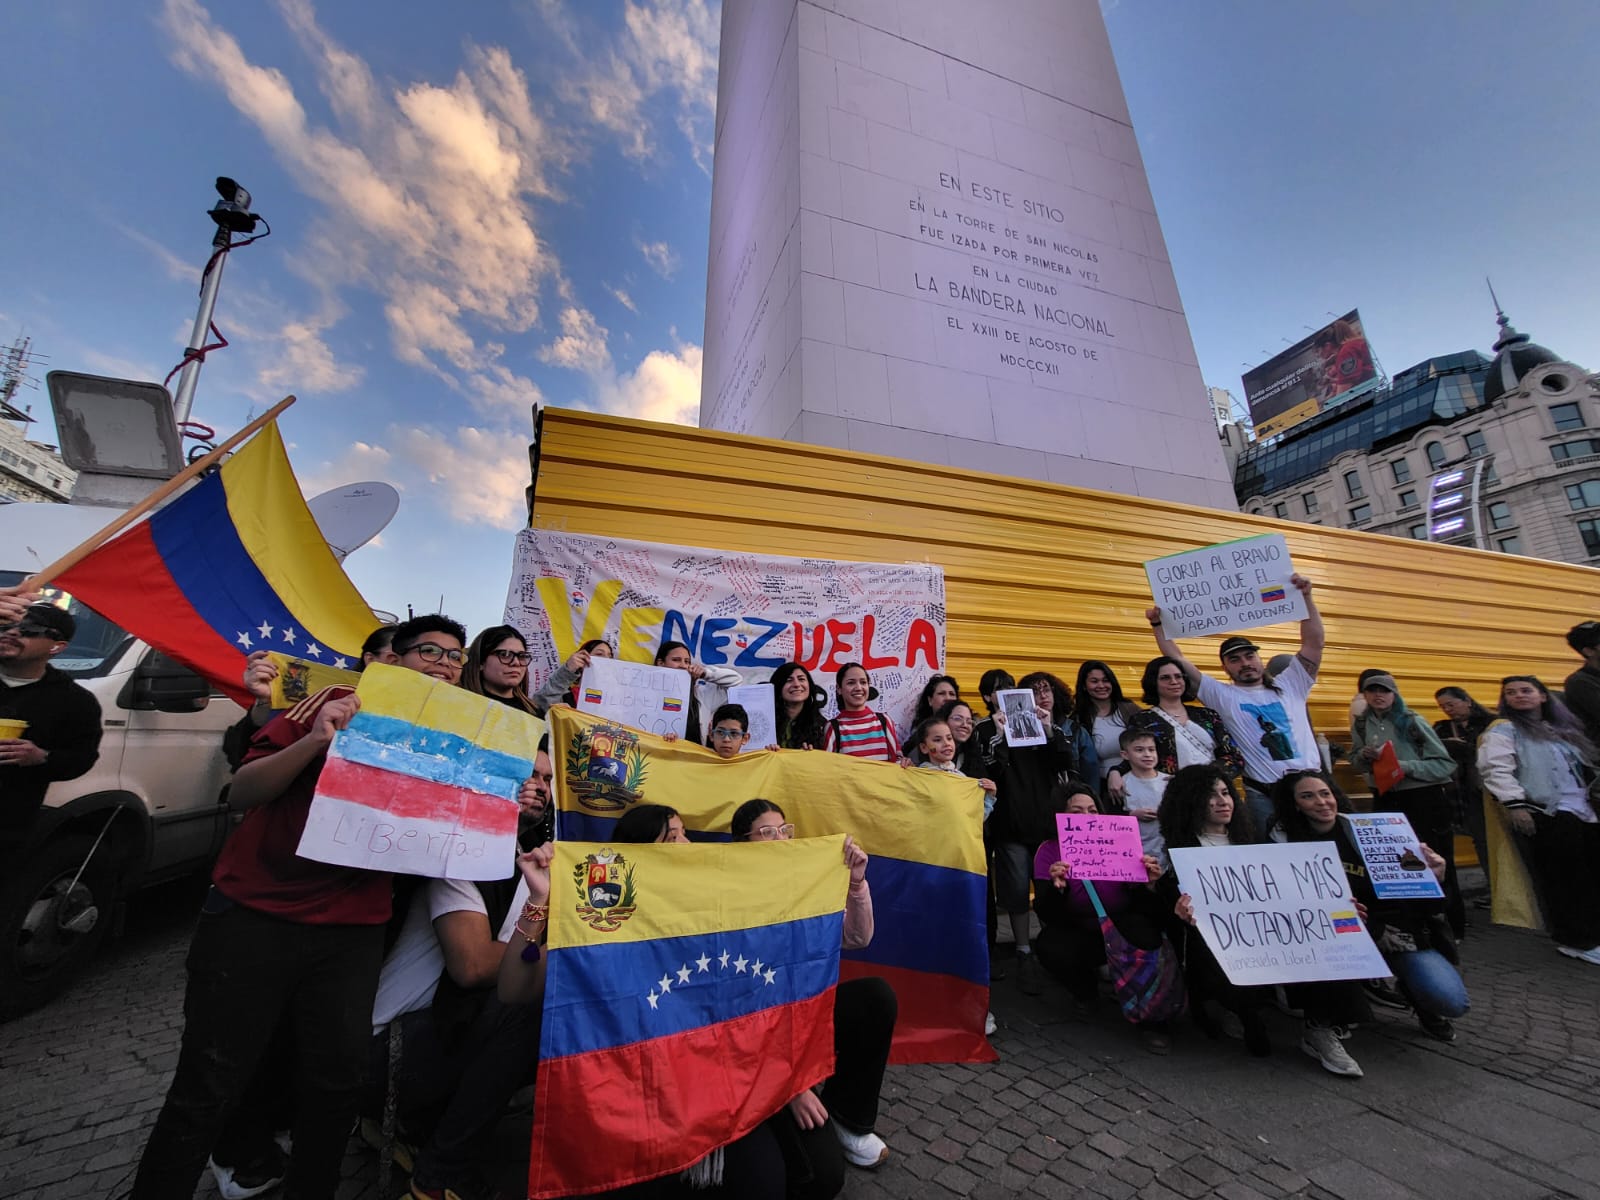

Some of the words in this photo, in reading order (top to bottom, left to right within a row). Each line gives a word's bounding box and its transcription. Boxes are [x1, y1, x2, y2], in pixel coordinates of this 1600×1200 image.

[939, 172, 961, 192] EN
[972, 182, 1014, 208] ESTE
[1023, 199, 1064, 223] SITIO
[909, 199, 925, 212] EN
[933, 207, 948, 219] LA
[956, 213, 996, 233] TORRE
[1004, 228, 1019, 240] DE
[1026, 234, 1047, 248] SAN
[1053, 243, 1099, 263] NICOLAS
[920, 225, 944, 240] FUE
[952, 234, 986, 252] IZADA
[994, 246, 1018, 261] POR
[1025, 255, 1072, 276] PRIMERA
[1078, 269, 1100, 283] VEZ
[973, 265, 989, 278] EN
[995, 271, 1010, 283] LA
[1017, 278, 1057, 296] CIUDAD
[914, 272, 938, 294] LA
[949, 281, 1026, 316] BANDERA
[1034, 303, 1114, 338] NACIONAL
[947, 317, 963, 330] EL
[972, 322, 998, 338] XXIII
[1005, 331, 1020, 343] DE
[1029, 336, 1077, 356] AGOSTO
[1083, 348, 1098, 361] DE
[1000, 353, 1060, 375] MDCCCXII
[1156, 561, 1203, 584] GLORIA
[1210, 554, 1227, 573] AL
[1231, 544, 1281, 569] BRAVO
[1163, 580, 1212, 603] PUEBLO
[1219, 571, 1246, 592] QUE
[1255, 568, 1277, 585] EL
[1168, 602, 1204, 621] YUGO
[1211, 587, 1256, 612] LANZÓ
[1181, 615, 1229, 634] ¡ABAJO
[1238, 601, 1295, 622] CADENAS!
[534, 576, 940, 673] VENEZUELA
[1064, 817, 1083, 832] La
[1359, 833, 1415, 845] ESTREÑIDA
[1363, 846, 1382, 854] HAY
[1196, 863, 1281, 905] NUNCA
[1290, 853, 1344, 900] MÁS
[1369, 865, 1386, 874] QUE
[1372, 873, 1400, 882] QUIERE
[1400, 872, 1425, 880] SALIR
[1209, 908, 1336, 951] DICTADURA
